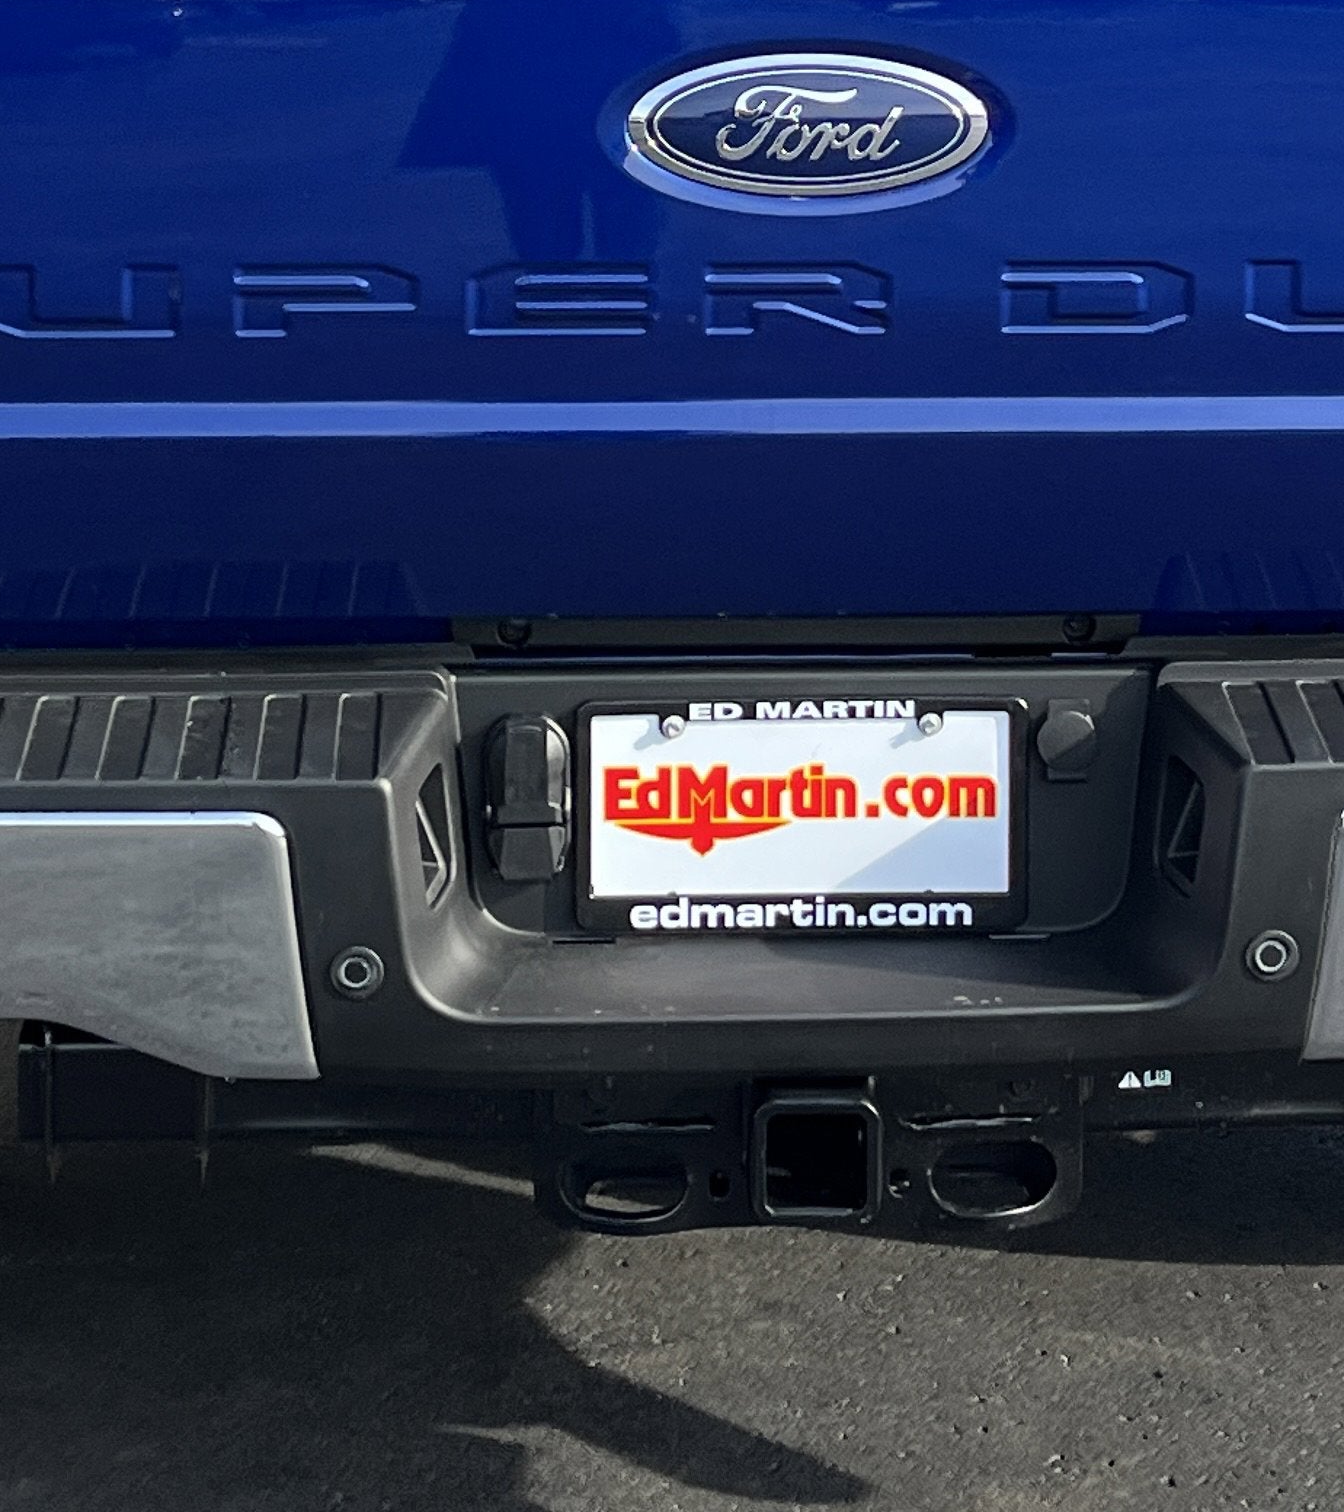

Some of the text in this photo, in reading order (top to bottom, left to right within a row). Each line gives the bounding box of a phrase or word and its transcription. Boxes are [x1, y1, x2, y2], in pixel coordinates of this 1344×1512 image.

[716, 85, 904, 161] Ford
[688, 699, 916, 721] ED MARTIN
[602, 762, 997, 822] EdMartin.com
[629, 897, 973, 929] edmartin.com
